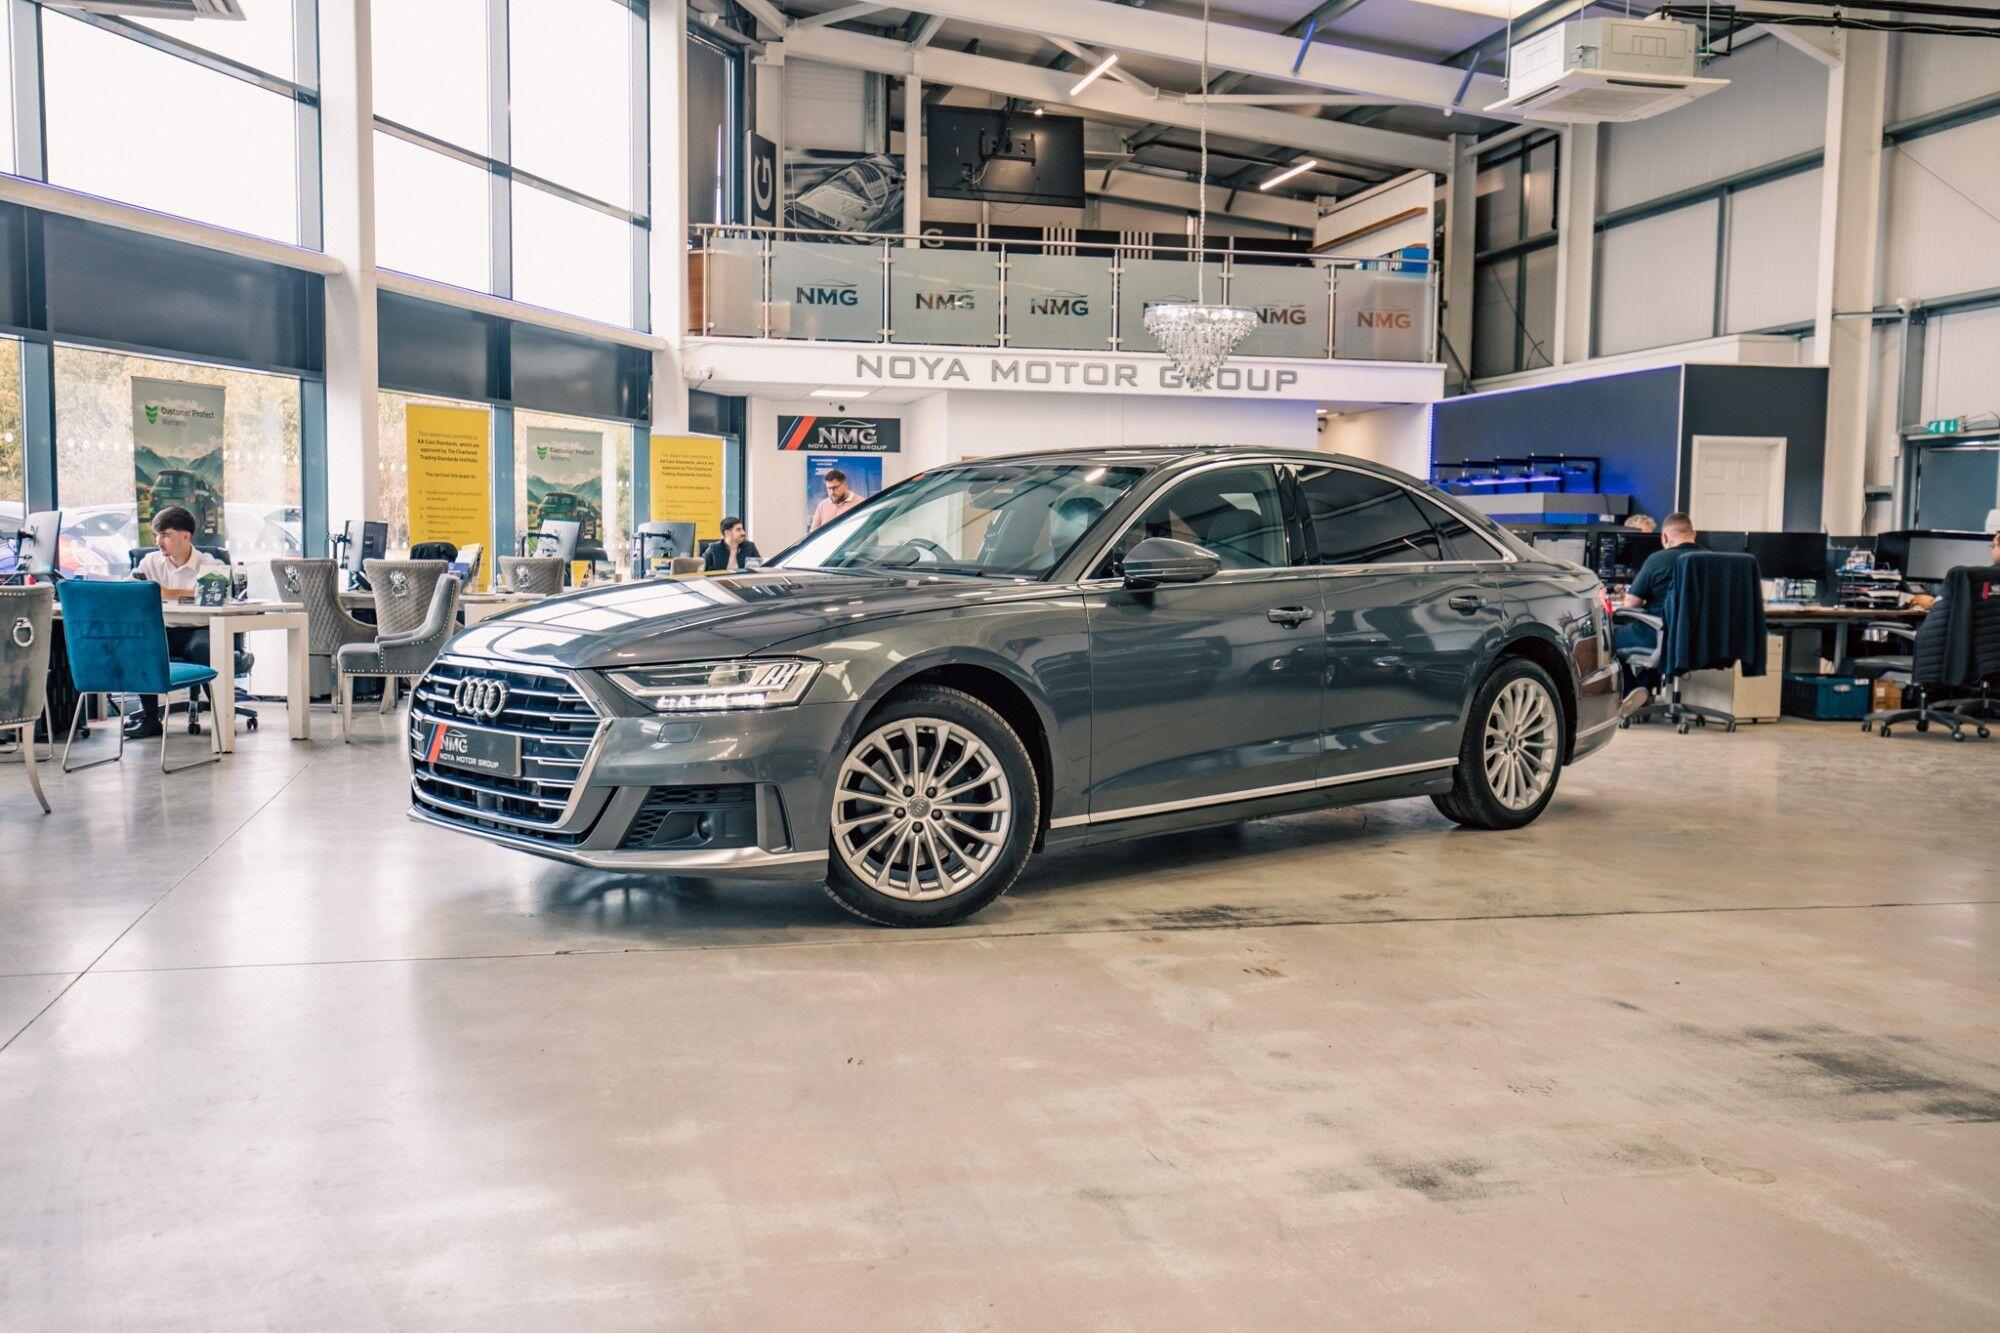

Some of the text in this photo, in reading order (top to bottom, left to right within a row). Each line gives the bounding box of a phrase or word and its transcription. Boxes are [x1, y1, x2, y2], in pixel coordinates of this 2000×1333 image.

[796, 286, 858, 306] NMG
[916, 293, 975, 310] NMG
[1031, 299, 1089, 316] NMG
[1357, 311, 1411, 329] NMG
[857, 354, 970, 381] NOYA
[991, 359, 1138, 387] MOTOR
[192, 409, 215, 419] Protect
[818, 428, 878, 444] NMG
[440, 735, 468, 753] NMG
[456, 755, 477, 764] MOTOR
[478, 759, 499, 768] GROUP
